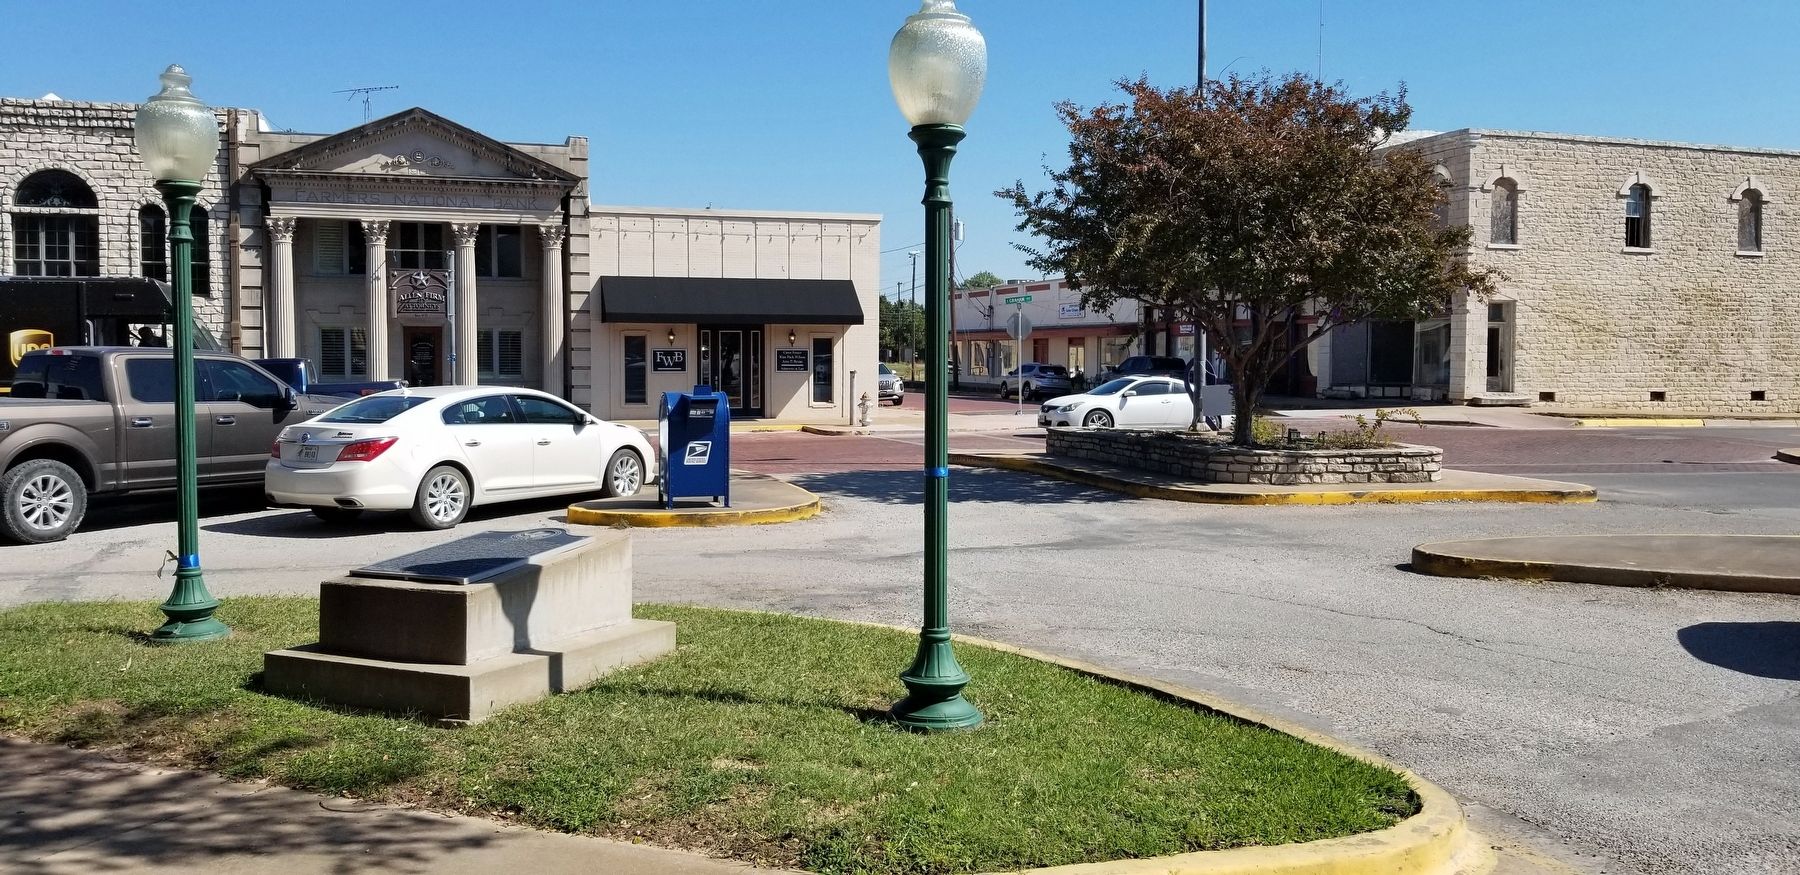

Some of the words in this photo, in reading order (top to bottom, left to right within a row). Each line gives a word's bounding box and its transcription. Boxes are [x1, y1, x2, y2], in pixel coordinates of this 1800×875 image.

[295, 191, 380, 204] FARMERS
[394, 194, 478, 208] NATIONAL
[493, 198, 538, 210] BANK
[399, 292, 423, 301] ALLEN
[426, 292, 445, 302] FIRM
[656, 351, 684, 367] FWB
